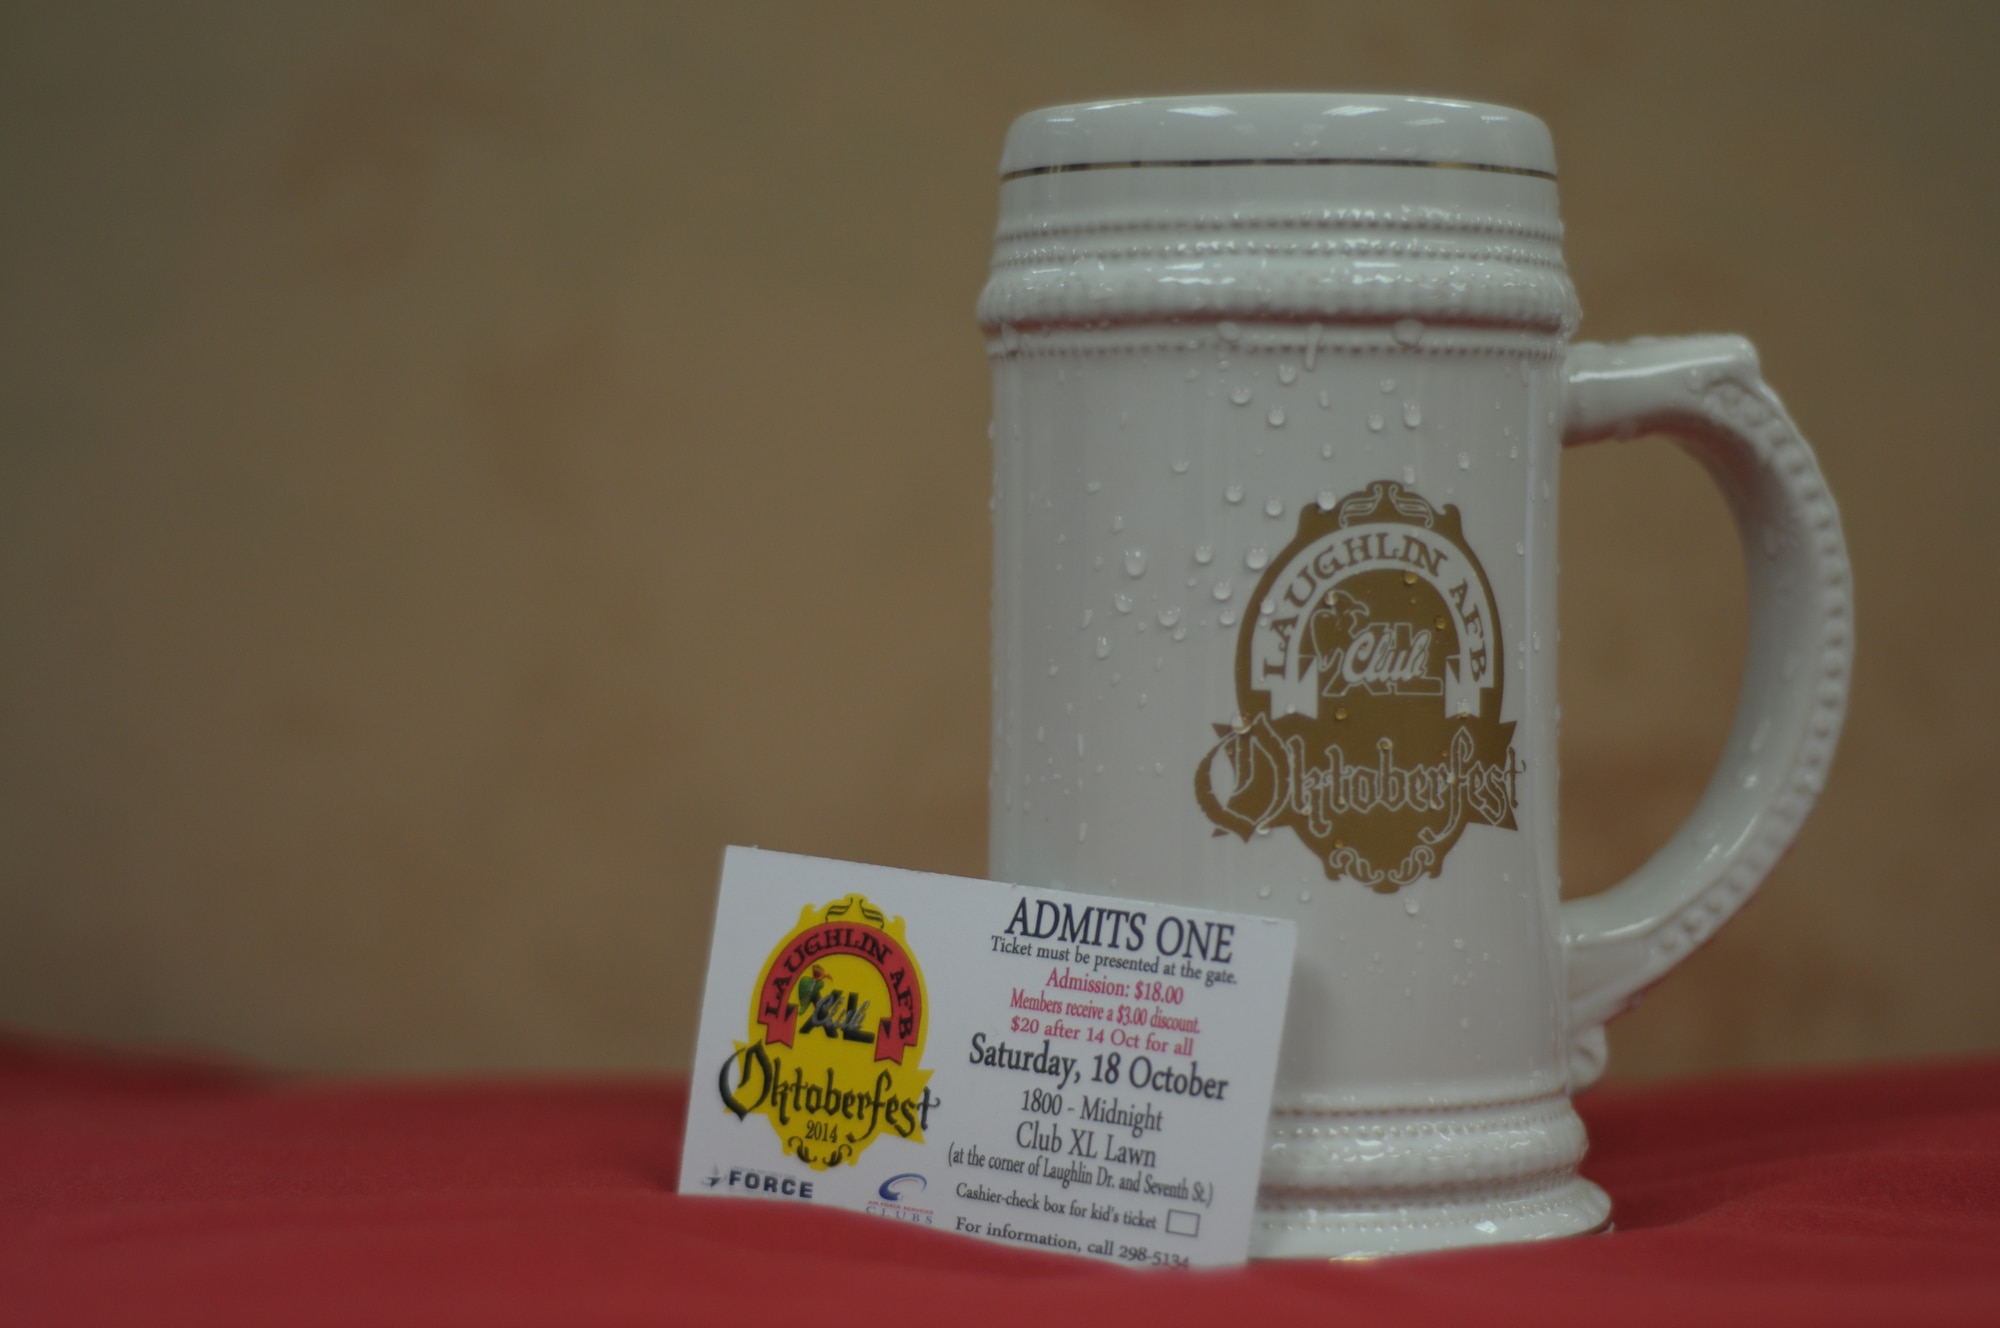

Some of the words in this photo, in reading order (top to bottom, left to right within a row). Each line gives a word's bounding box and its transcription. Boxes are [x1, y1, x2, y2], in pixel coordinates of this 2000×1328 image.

[1263, 532, 1448, 679] LAUGHLIN
[1449, 579, 1488, 683] AFB
[1193, 711, 1526, 844] Oktoberfest
[1004, 897, 1147, 951] ADMITS
[1156, 916, 1235, 964] ONE
[765, 928, 893, 1017] LAUGHLIN
[890, 967, 913, 1040] AFB
[990, 935, 1032, 957] Ticket
[1036, 947, 1070, 962] must
[1075, 945, 1090, 964] be
[1093, 953, 1159, 974] presented
[1163, 961, 1176, 976] at
[1180, 960, 1202, 980] the
[1205, 968, 1238, 988] gate.
[1045, 967, 1130, 998] Admission:
[1134, 980, 1184, 1006] $18.00
[1010, 988, 1063, 1016] Members
[1065, 1001, 1103, 1021] receive
[1106, 1008, 1113, 1022] a
[1116, 1004, 1148, 1027] $3.00
[1151, 1006, 1200, 1033] discount.
[1010, 1015, 1040, 1034] $20
[1044, 1020, 1080, 1042] after
[1087, 1025, 1104, 1043] 14
[1110, 1029, 1140, 1049] Oct
[1146, 1033, 1169, 1054] for
[1174, 1037, 1193, 1057] all
[718, 1038, 941, 1144] Oktoberfest
[969, 1032, 1081, 1089] Saturday,
[1091, 1052, 1121, 1085] 18
[1129, 1056, 1228, 1100] October
[805, 1120, 838, 1143] 2014
[1021, 1088, 1062, 1115] 1800
[1080, 1095, 1163, 1138] Midnight
[1016, 1120, 1062, 1153] Club
[1068, 1127, 1098, 1159] XL
[1103, 1134, 1157, 1168] Lawn
[728, 1169, 814, 1198] FORCE
[948, 1141, 964, 1167] (at
[967, 1144, 986, 1167] the
[988, 1155, 1025, 1174] corner
[1027, 1156, 1041, 1176] of
[1042, 1157, 1093, 1189] Laughlin
[1096, 1166, 1115, 1188] Dr.
[1119, 1171, 1141, 1193] and
[1144, 1174, 1189, 1201] Seventh
[1191, 1181, 1214, 1208] St.)
[956, 1182, 1039, 1210] Cashier-check
[1043, 1194, 1066, 1215] box
[1069, 1199, 1087, 1219] for
[1090, 1203, 1121, 1224] kid's
[1122, 1209, 1157, 1230] ticket
[955, 1217, 982, 1234] For
[986, 1221, 1082, 1252] information,
[1087, 1239, 1114, 1256] call
[1118, 1244, 1190, 1270] 298-5134
